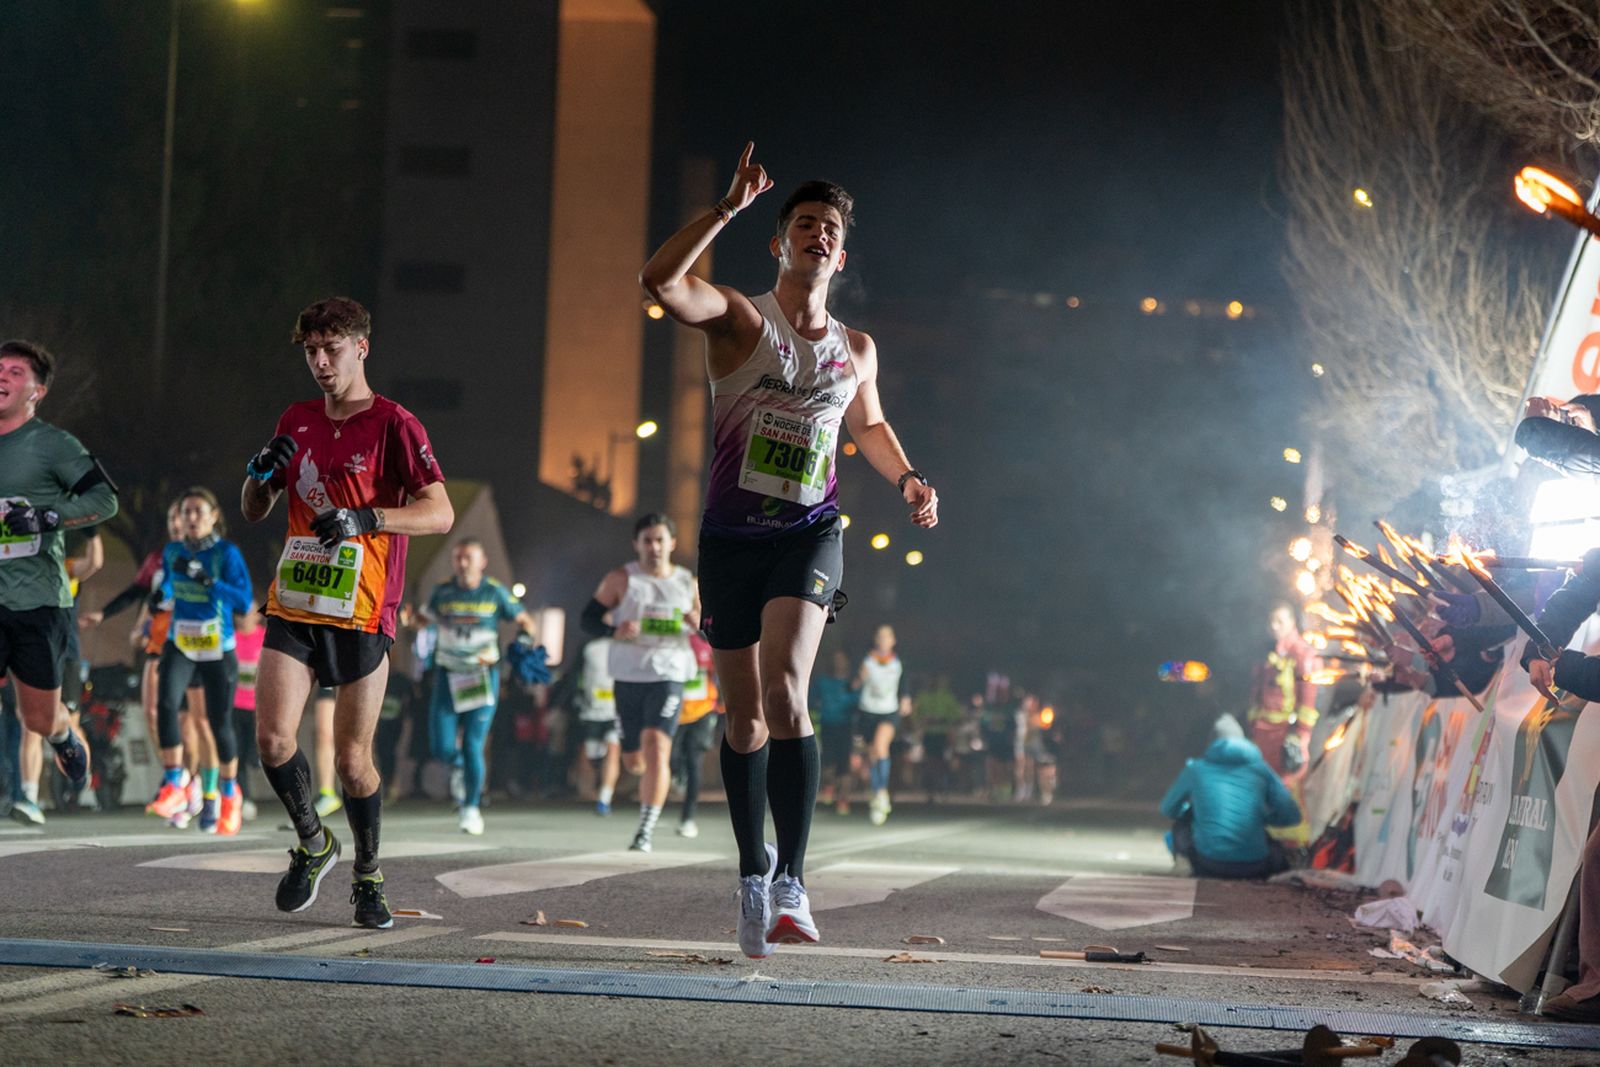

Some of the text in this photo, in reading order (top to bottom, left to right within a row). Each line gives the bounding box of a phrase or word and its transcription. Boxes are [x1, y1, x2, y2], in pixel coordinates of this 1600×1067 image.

[753, 374, 845, 408] SIERRA DE SEGURA
[760, 427, 779, 439] SAN
[773, 419, 801, 433] NOCHE
[801, 425, 812, 437] DE
[763, 439, 819, 476] 7306
[307, 487, 325, 507] 43
[290, 552, 305, 560] SAN
[300, 544, 323, 554] NOCHE
[293, 561, 344, 590] 6497
